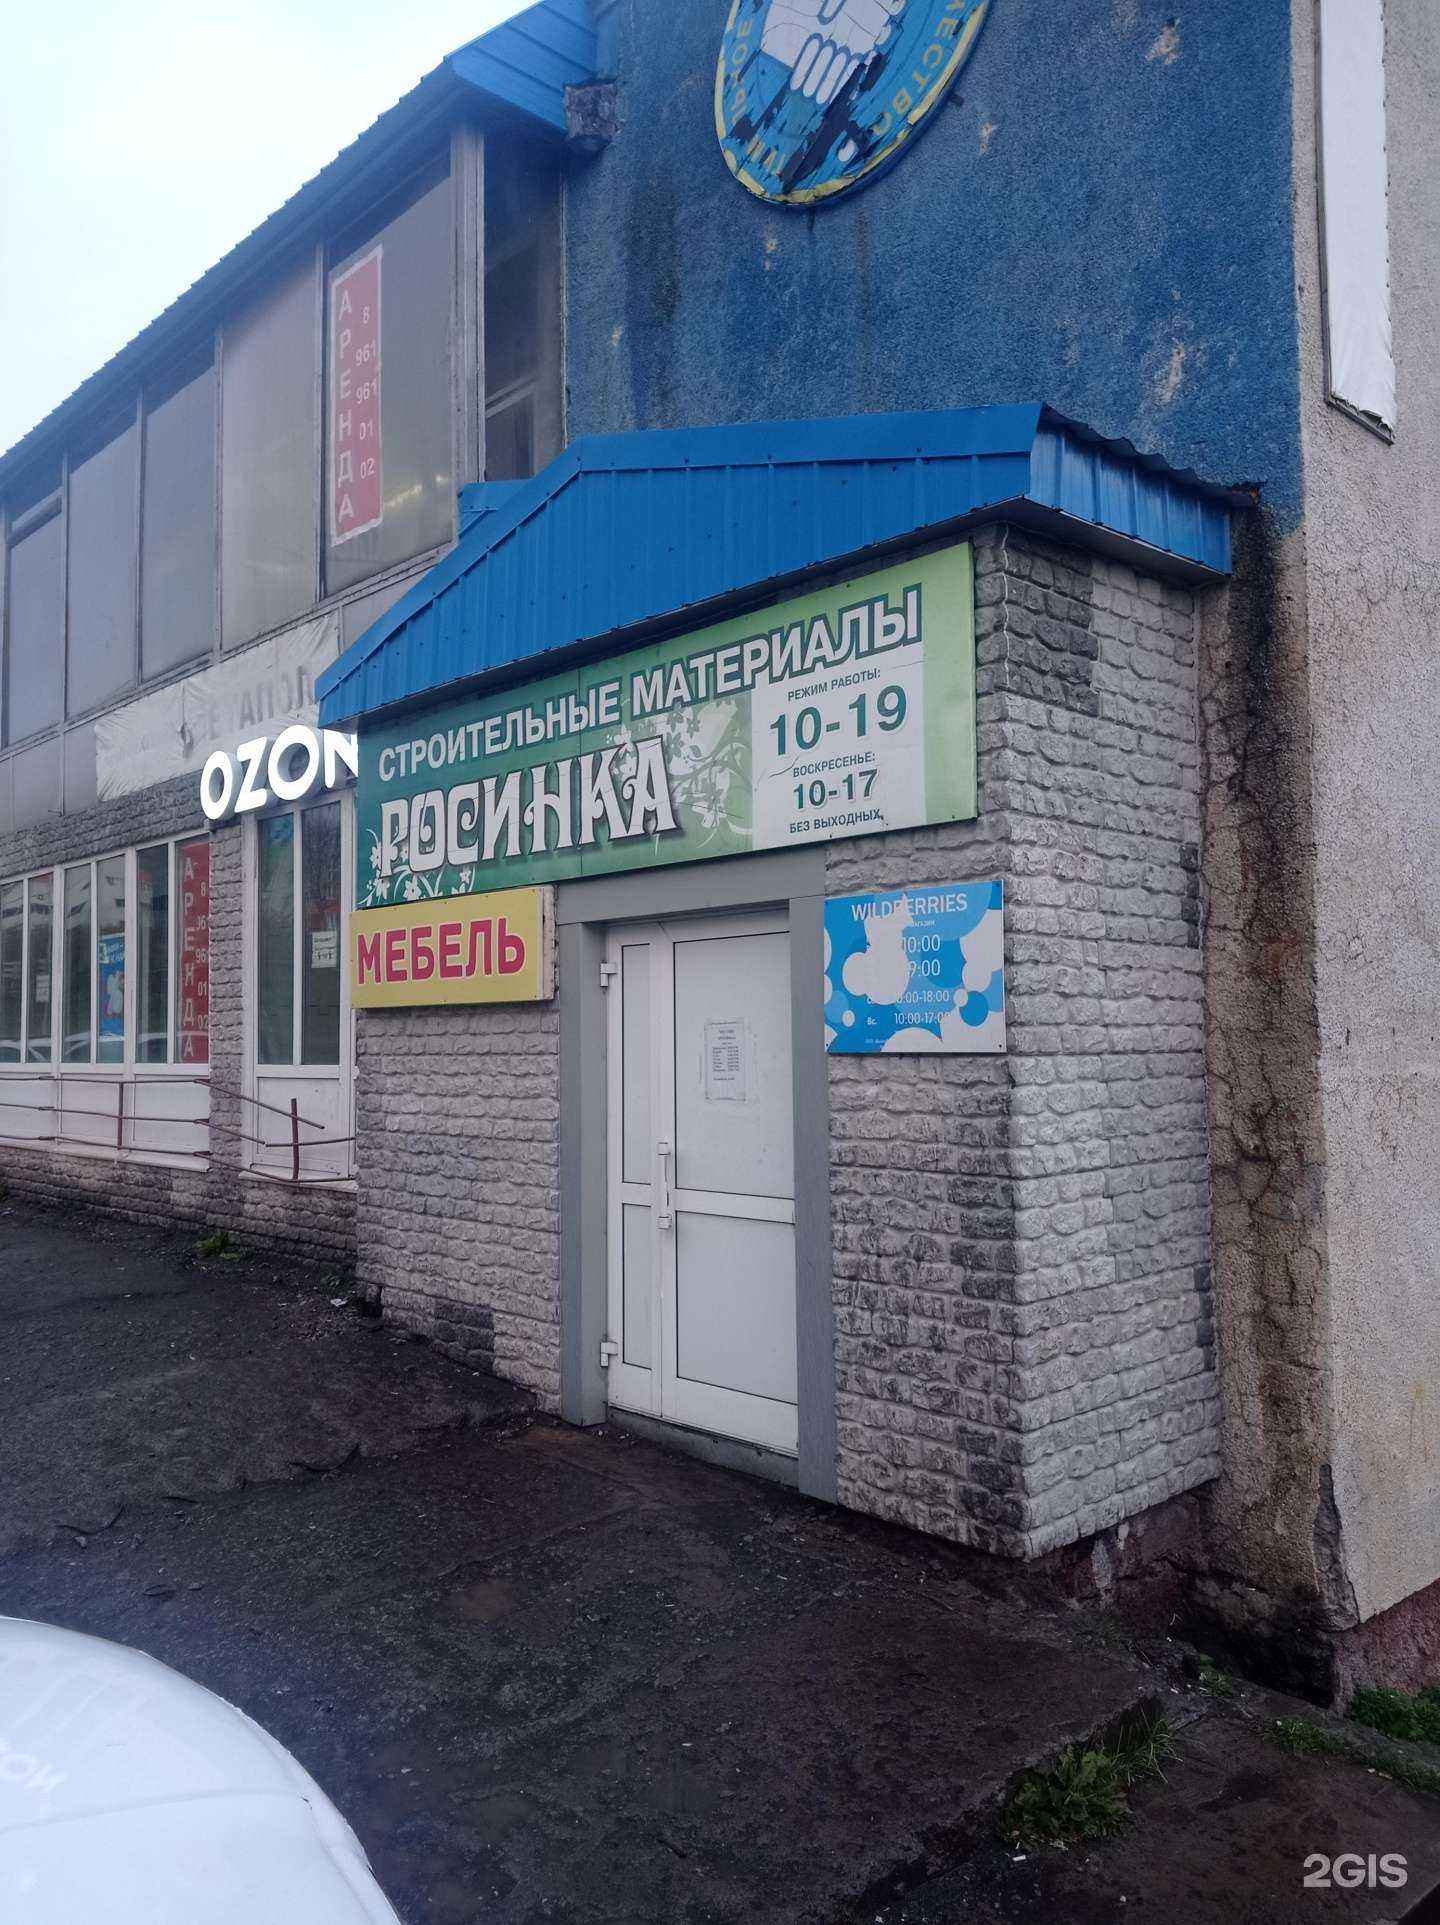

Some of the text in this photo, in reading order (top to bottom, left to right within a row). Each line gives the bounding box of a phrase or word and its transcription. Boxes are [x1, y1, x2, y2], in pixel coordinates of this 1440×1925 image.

[337, 290, 354, 523] АРЕНДА
[359, 419, 374, 440] 01
[360, 458, 375, 480] 02
[378, 681, 620, 782] СТРОИТЕЛЬНЫЕ
[632, 588, 919, 718] МАТЕРИАЛЫ
[788, 668, 881, 701] РЕЖИМ РАБОТЫ:
[770, 685, 908, 756] 10-19
[200, 724, 358, 820] OZON
[793, 752, 876, 778] ВОСКРЕСЕНЬЕ:
[793, 768, 878, 810] 10-17
[380, 735, 678, 878] РОСИНКА
[789, 808, 881, 834] БЕЗ ВЫХОДНЫХ
[184, 857, 196, 1057] АРЕНДА
[357, 917, 526, 985] МЕБЕЛЬ
